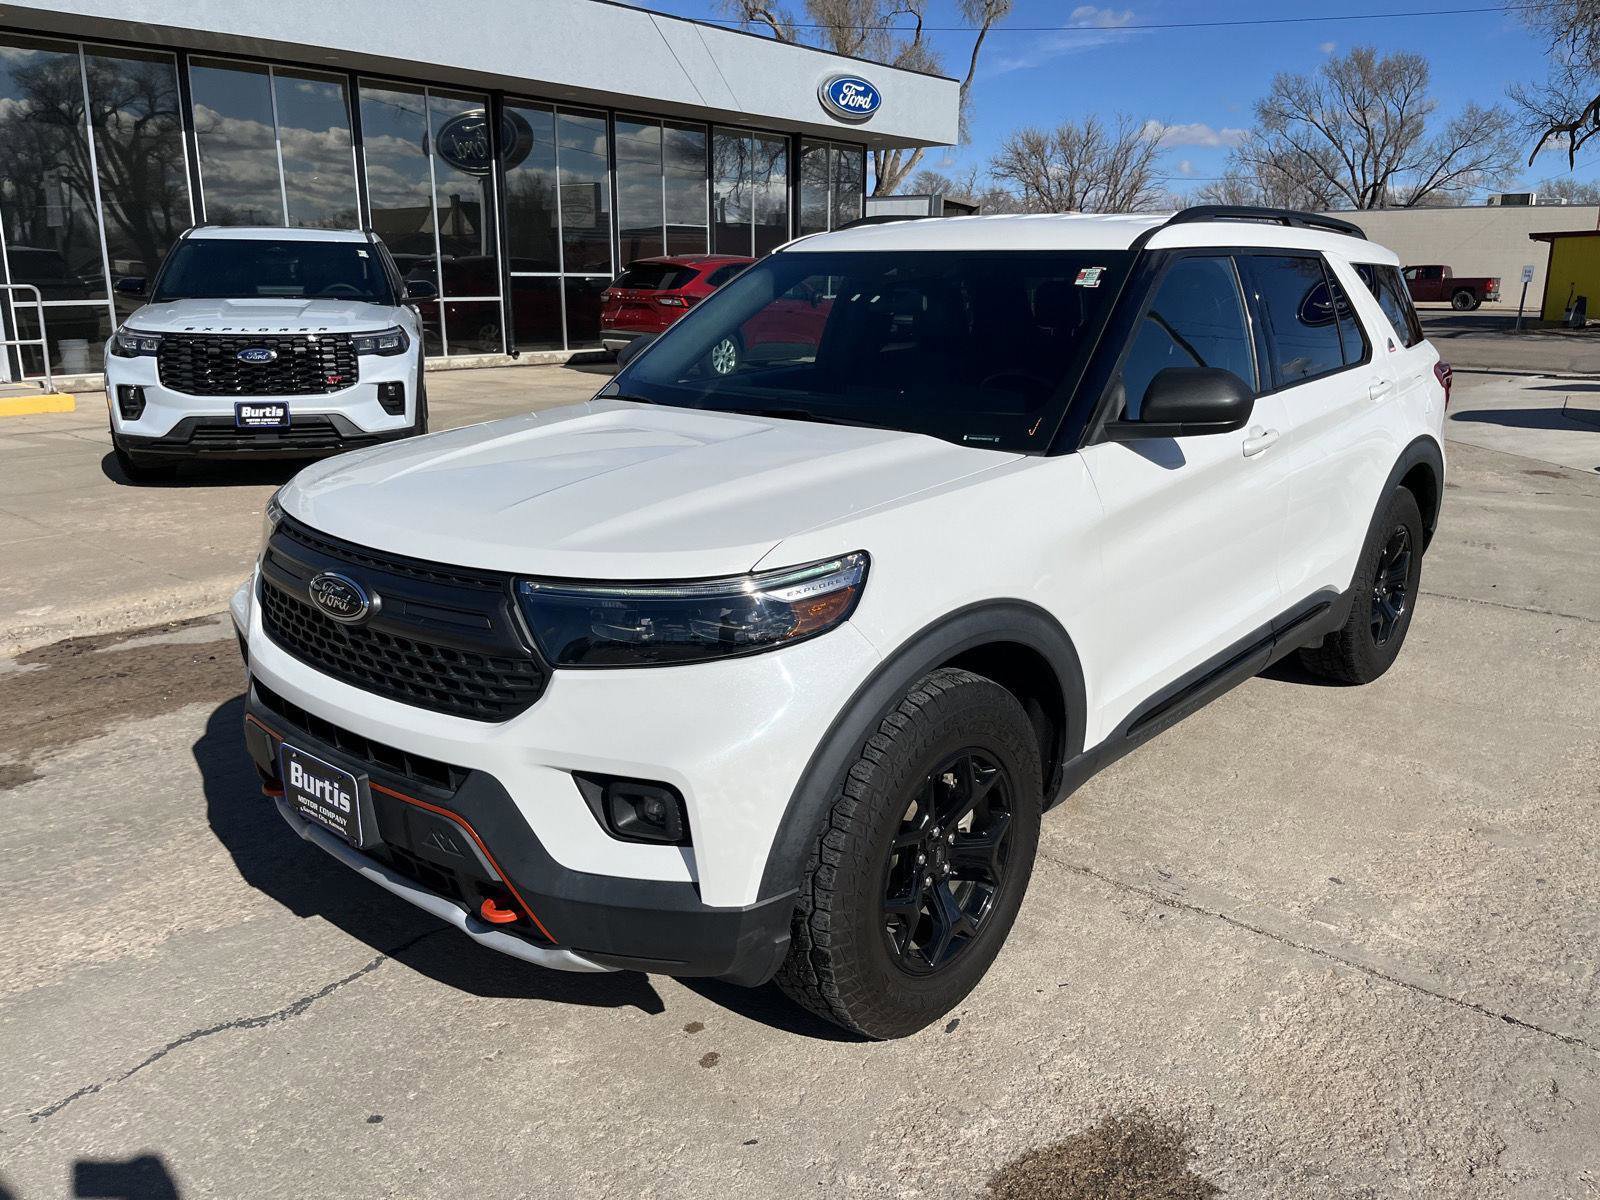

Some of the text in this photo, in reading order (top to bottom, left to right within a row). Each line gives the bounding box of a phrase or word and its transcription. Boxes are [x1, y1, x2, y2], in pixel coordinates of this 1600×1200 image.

[839, 82, 873, 109] Ford
[246, 351, 269, 360] Ford
[241, 406, 284, 418] Burtis
[318, 581, 352, 611] Ford
[786, 576, 850, 597] EXPLORER
[290, 761, 351, 813] Burtis
[297, 794, 348, 826] MOTOR COMPANY
